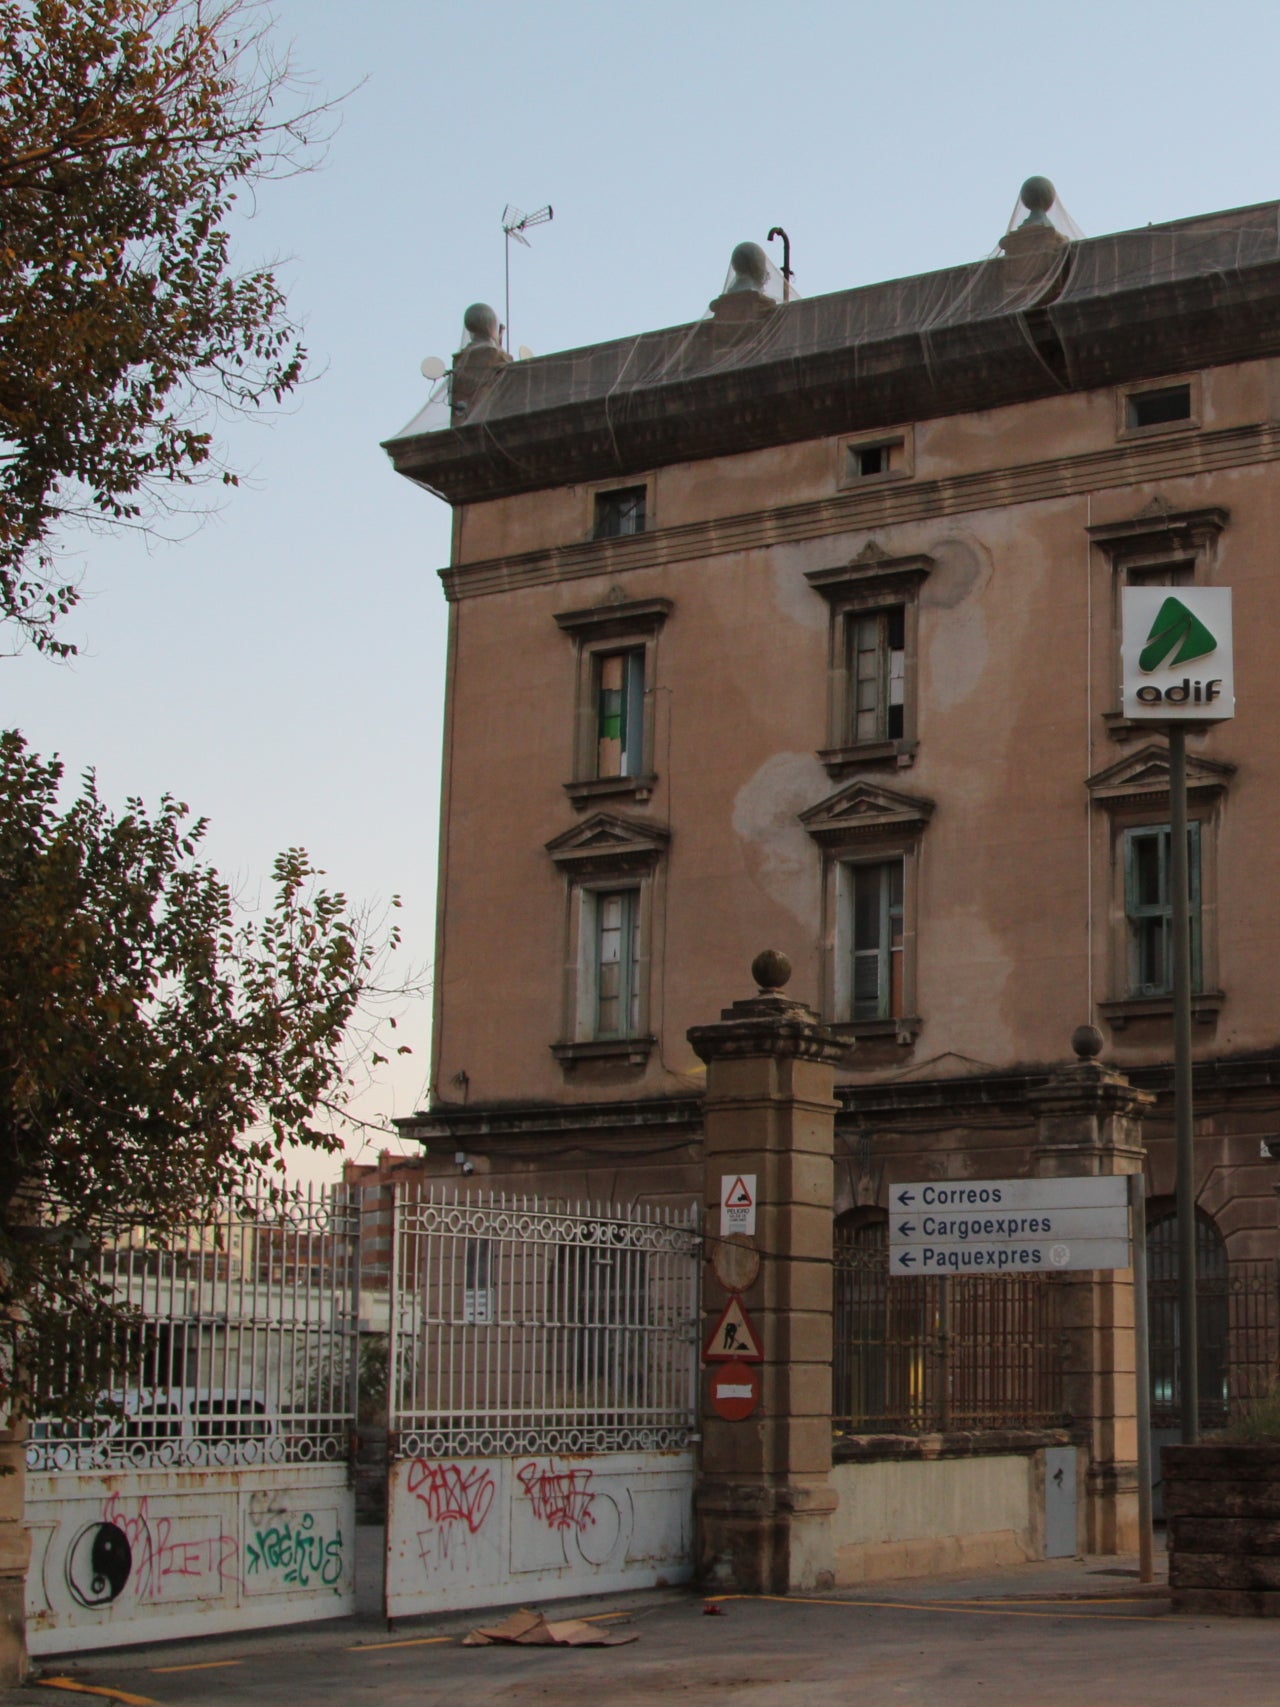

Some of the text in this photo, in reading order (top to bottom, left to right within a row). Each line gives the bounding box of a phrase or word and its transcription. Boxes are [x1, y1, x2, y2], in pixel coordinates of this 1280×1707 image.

[1136, 678, 1222, 702] adif
[922, 1187, 1002, 1205] Correos
[922, 1217, 1051, 1239] Cargoexpres
[922, 1248, 1042, 1270] Paquexpres
